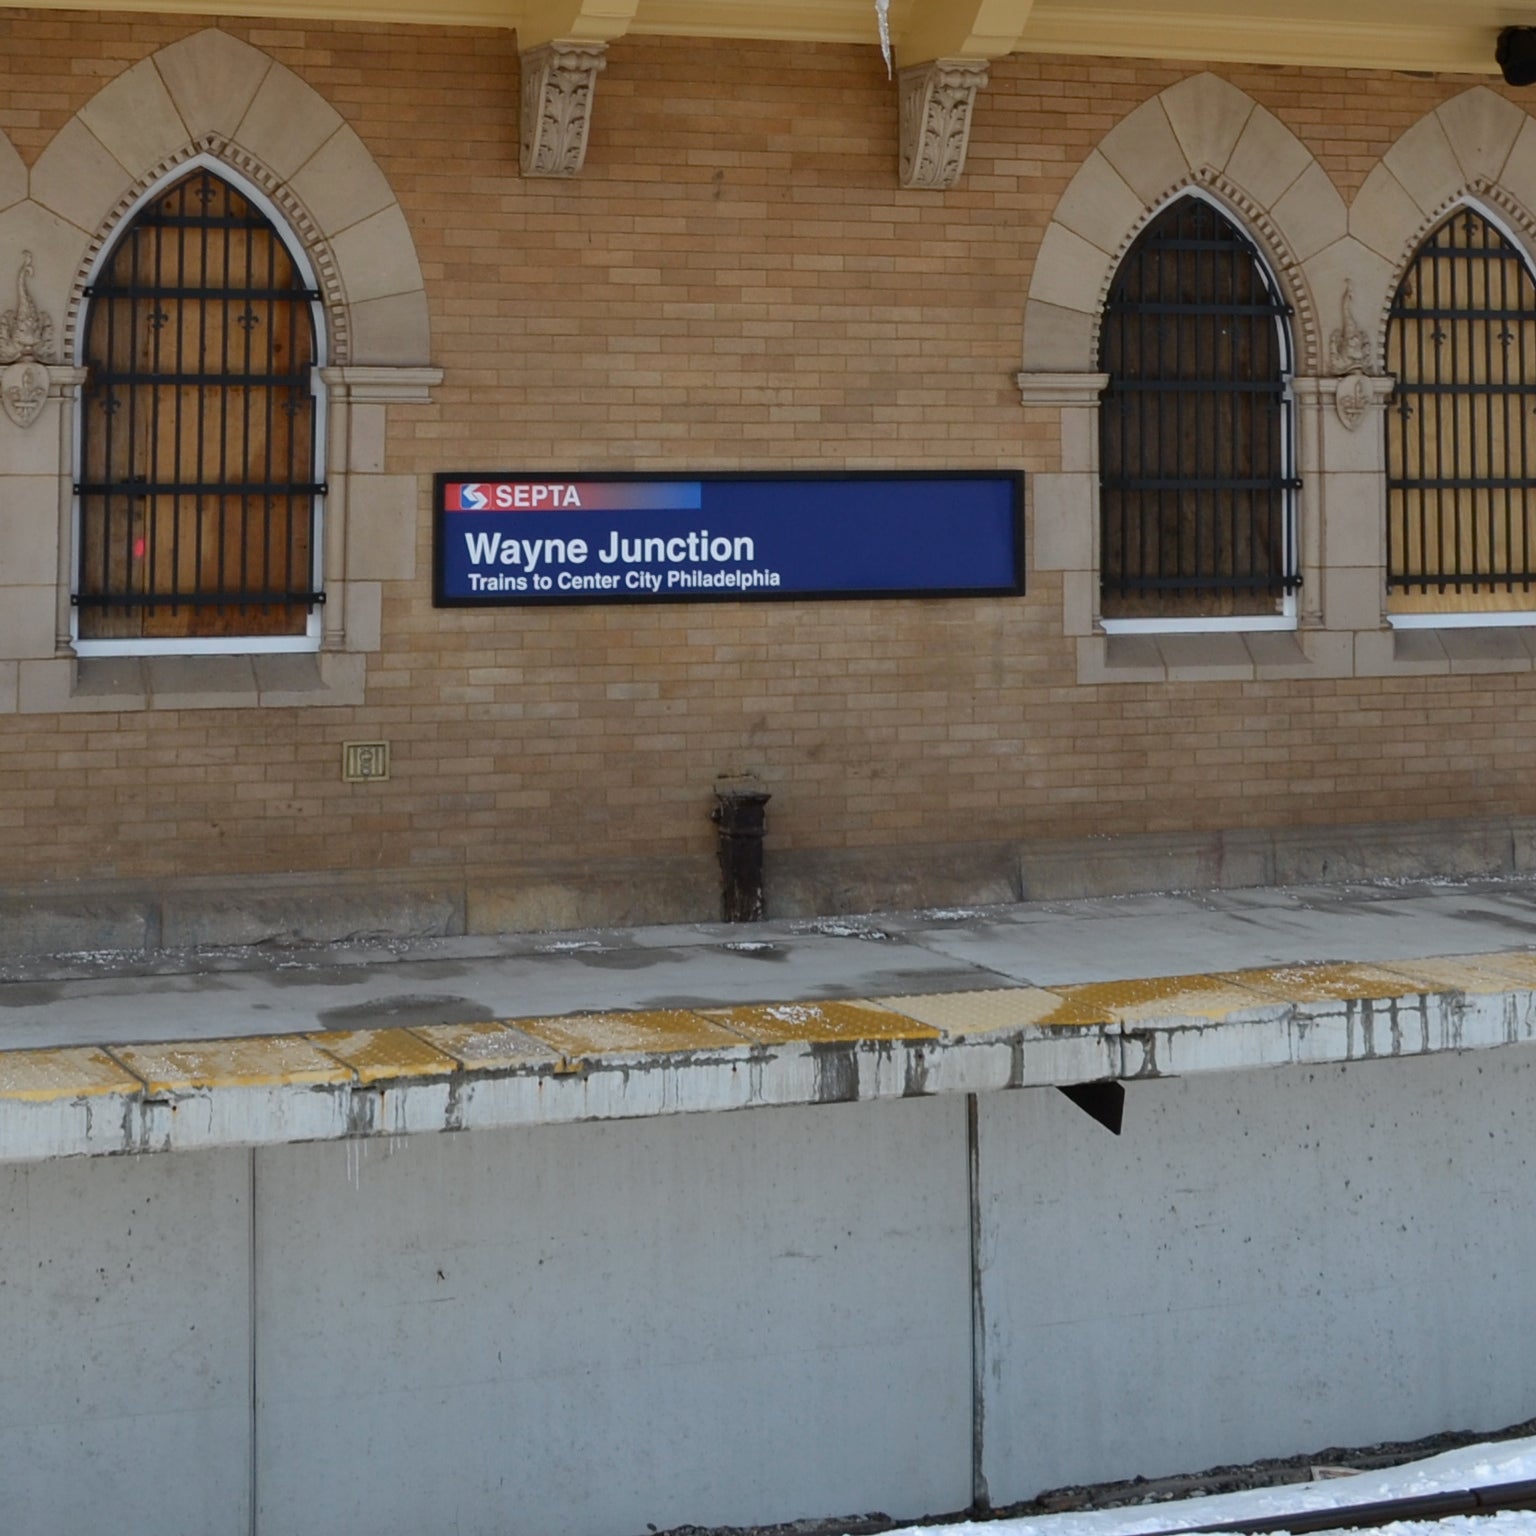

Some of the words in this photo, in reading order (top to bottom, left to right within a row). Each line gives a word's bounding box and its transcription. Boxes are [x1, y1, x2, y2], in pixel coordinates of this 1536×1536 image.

[495, 485, 582, 508] SEPTA
[464, 532, 589, 573] Wayne
[598, 530, 755, 564] Junction
[467, 572, 528, 591] Trains
[532, 573, 553, 591] to
[557, 571, 621, 590] Center
[625, 570, 663, 593] City
[667, 569, 781, 591] Philadelphia
